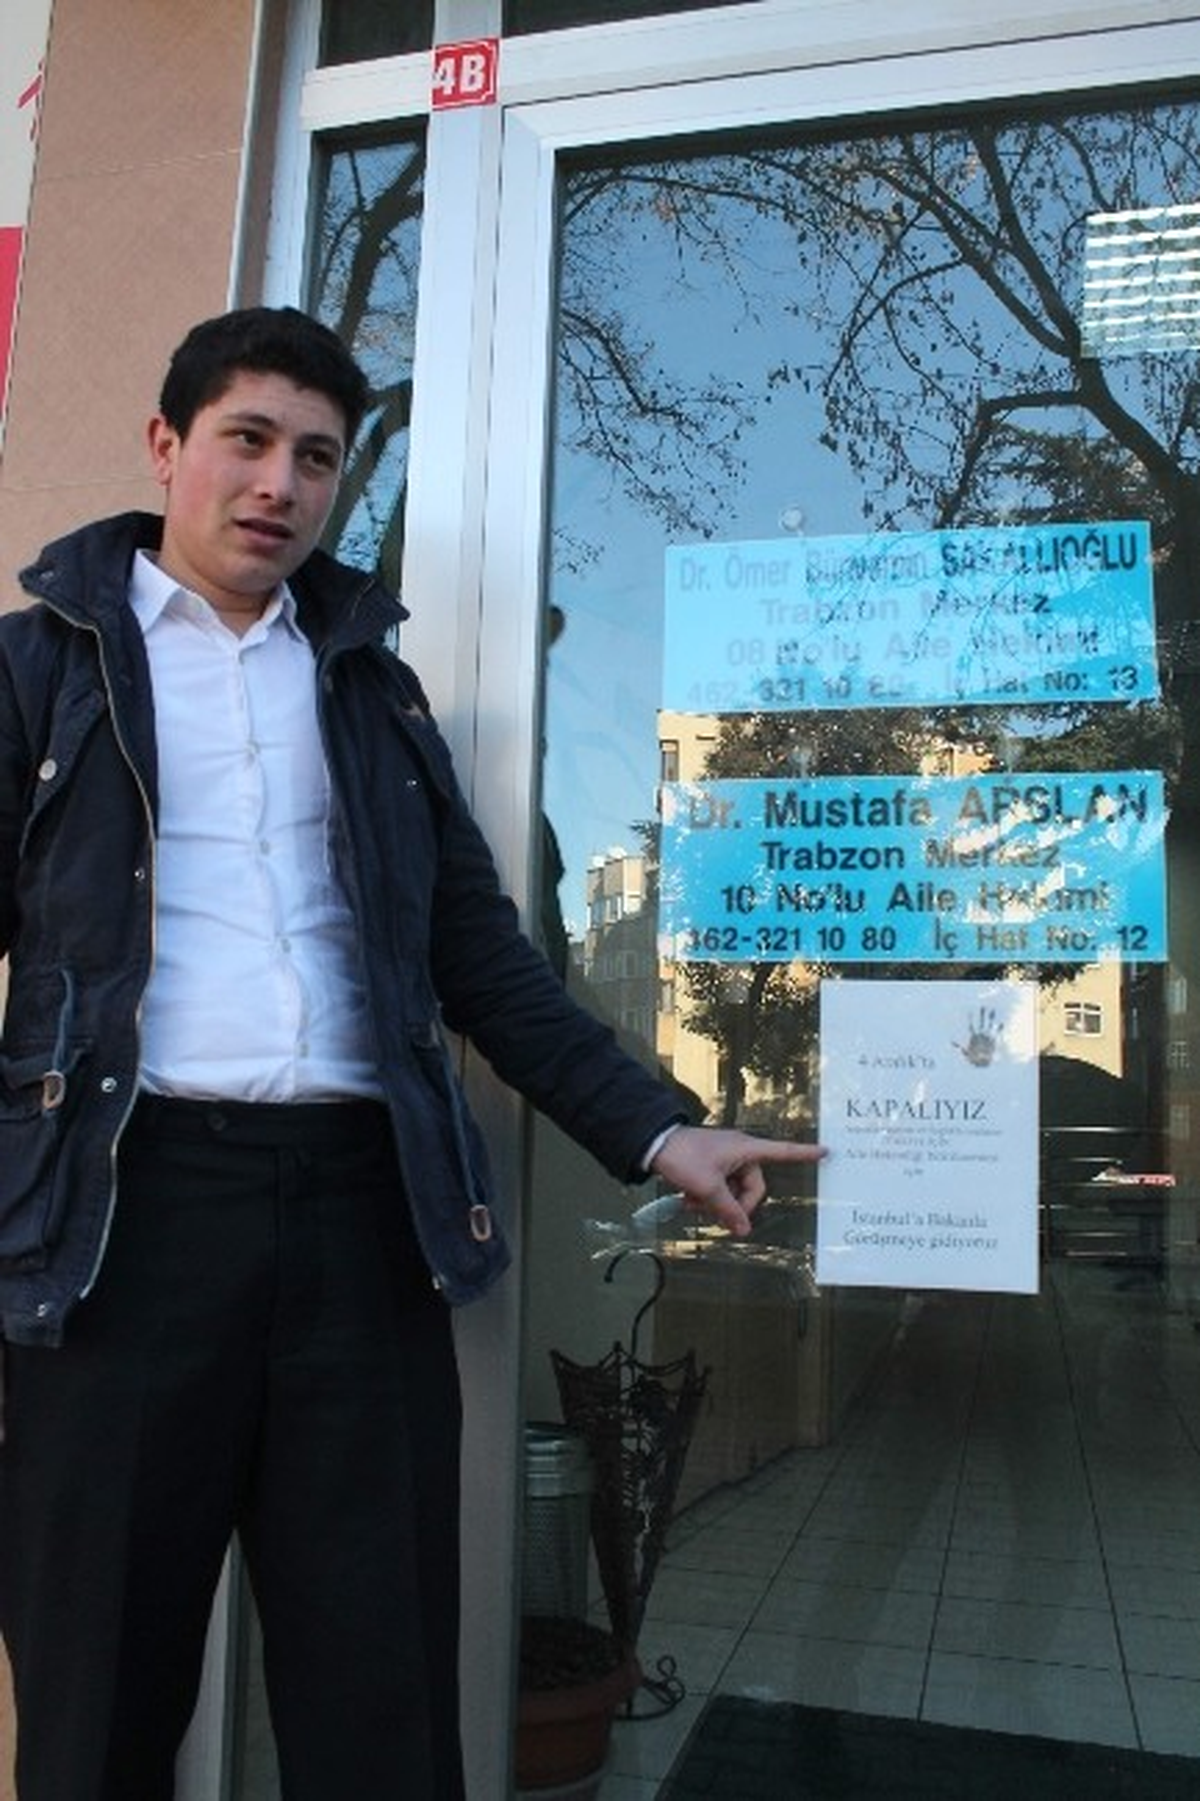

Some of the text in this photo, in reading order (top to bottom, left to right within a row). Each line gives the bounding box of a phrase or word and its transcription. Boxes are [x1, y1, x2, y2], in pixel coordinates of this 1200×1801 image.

[433, 55, 486, 95] 4B
[680, 557, 711, 591] Dr.
[725, 553, 791, 589] Ömer
[760, 597, 898, 626] Trabzon
[1043, 671, 1088, 692] No:
[1107, 665, 1138, 691] 13
[689, 793, 741, 829] Dr.
[764, 788, 933, 829] Mustafa
[760, 841, 905, 870] Trabzon
[721, 884, 755, 915] 10
[776, 882, 866, 914] No'lu
[886, 881, 957, 913] Aile
[818, 926, 846, 952] 10
[862, 926, 896, 952] 80
[976, 925, 1028, 952] Hat
[1115, 925, 1149, 952] 12
[846, 1099, 988, 1121] KAPALIYIZ
